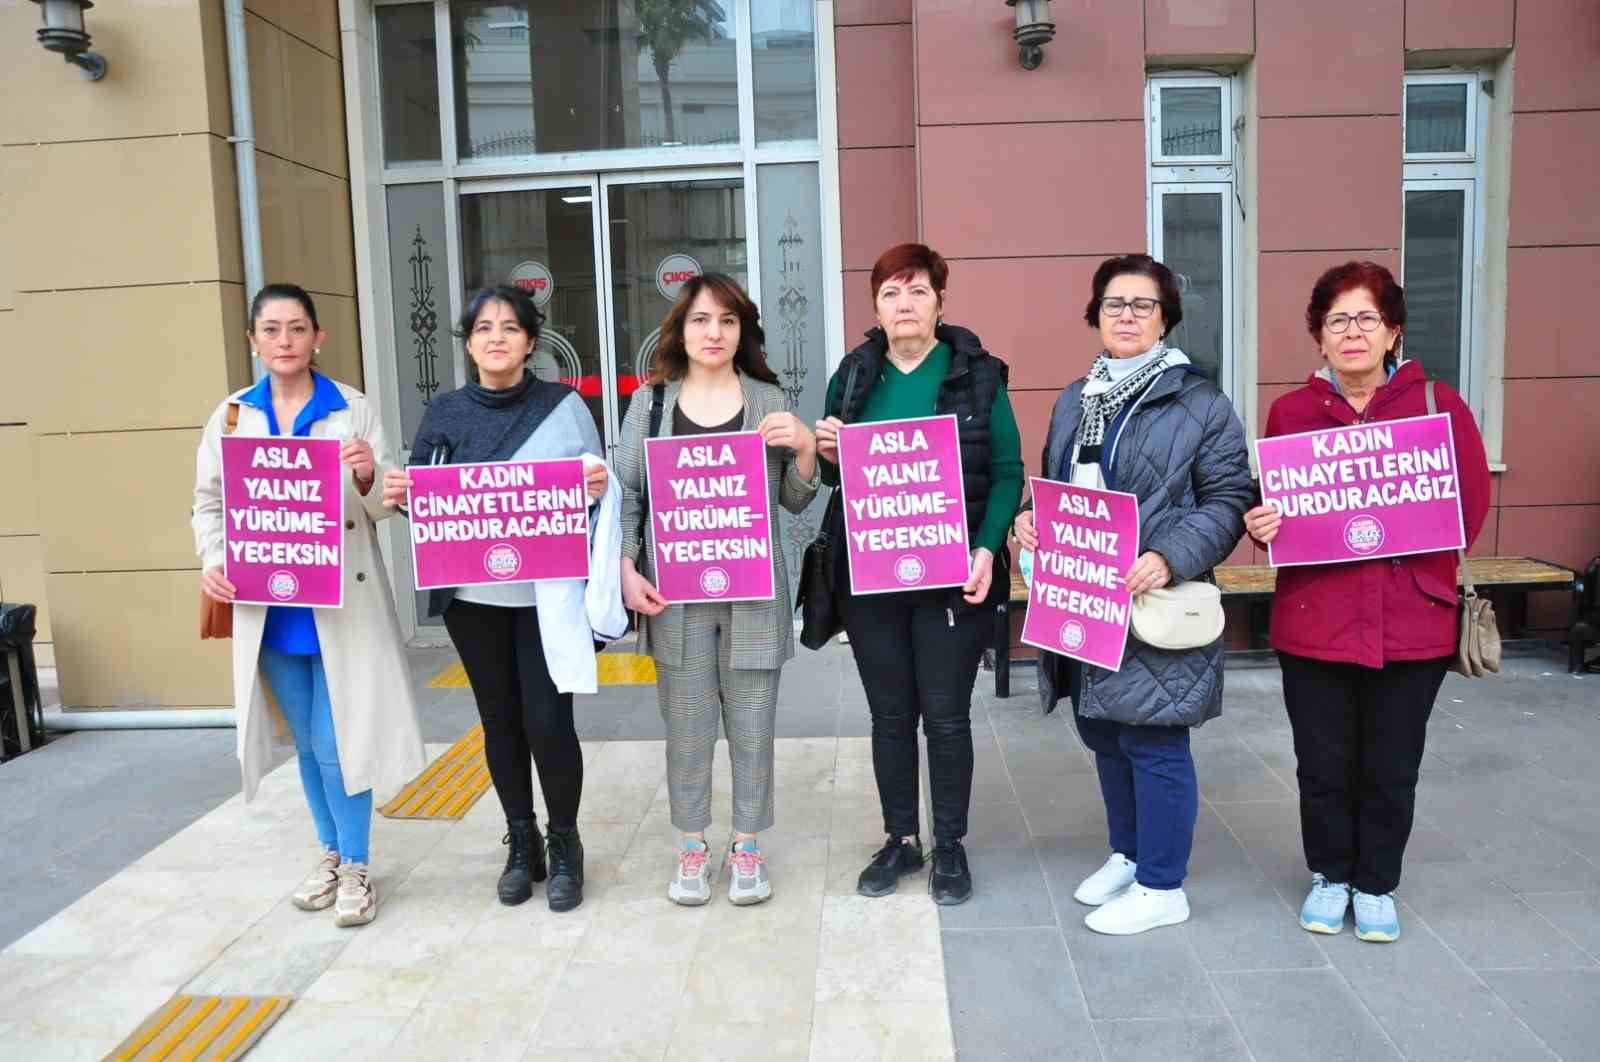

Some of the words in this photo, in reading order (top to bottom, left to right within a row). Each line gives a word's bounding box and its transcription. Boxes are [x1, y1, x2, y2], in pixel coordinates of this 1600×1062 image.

[676, 444, 736, 469] ASLA
[868, 429, 929, 455] ASLA
[1311, 426, 1394, 458] KADIN
[251, 446, 312, 470] ASLA
[1265, 442, 1450, 492] CİNAYETLERİNİ
[459, 464, 535, 489] KADIN
[669, 474, 748, 500] YALNIZ
[862, 459, 941, 488] YALNIZ
[243, 477, 322, 502] YALNIZ
[414, 483, 583, 518] CİNAYETLERİNİ
[1264, 474, 1457, 518] DURDURACAĞIZ
[229, 505, 337, 534] YÜRÜME-
[656, 504, 764, 533] YÜRÜME-
[850, 491, 958, 521] YÜRÜME-
[1058, 492, 1111, 521] ASLA
[413, 511, 587, 544] DURDURACAĞIZ
[851, 520, 963, 552] YECEKSİN
[1051, 520, 1120, 556] YALNIZ
[228, 540, 339, 566] YECEKSİN
[658, 534, 768, 563] YECEKSİN
[1038, 550, 1128, 590] YÜRÜME-
[1034, 580, 1126, 626] YECEKSİN
